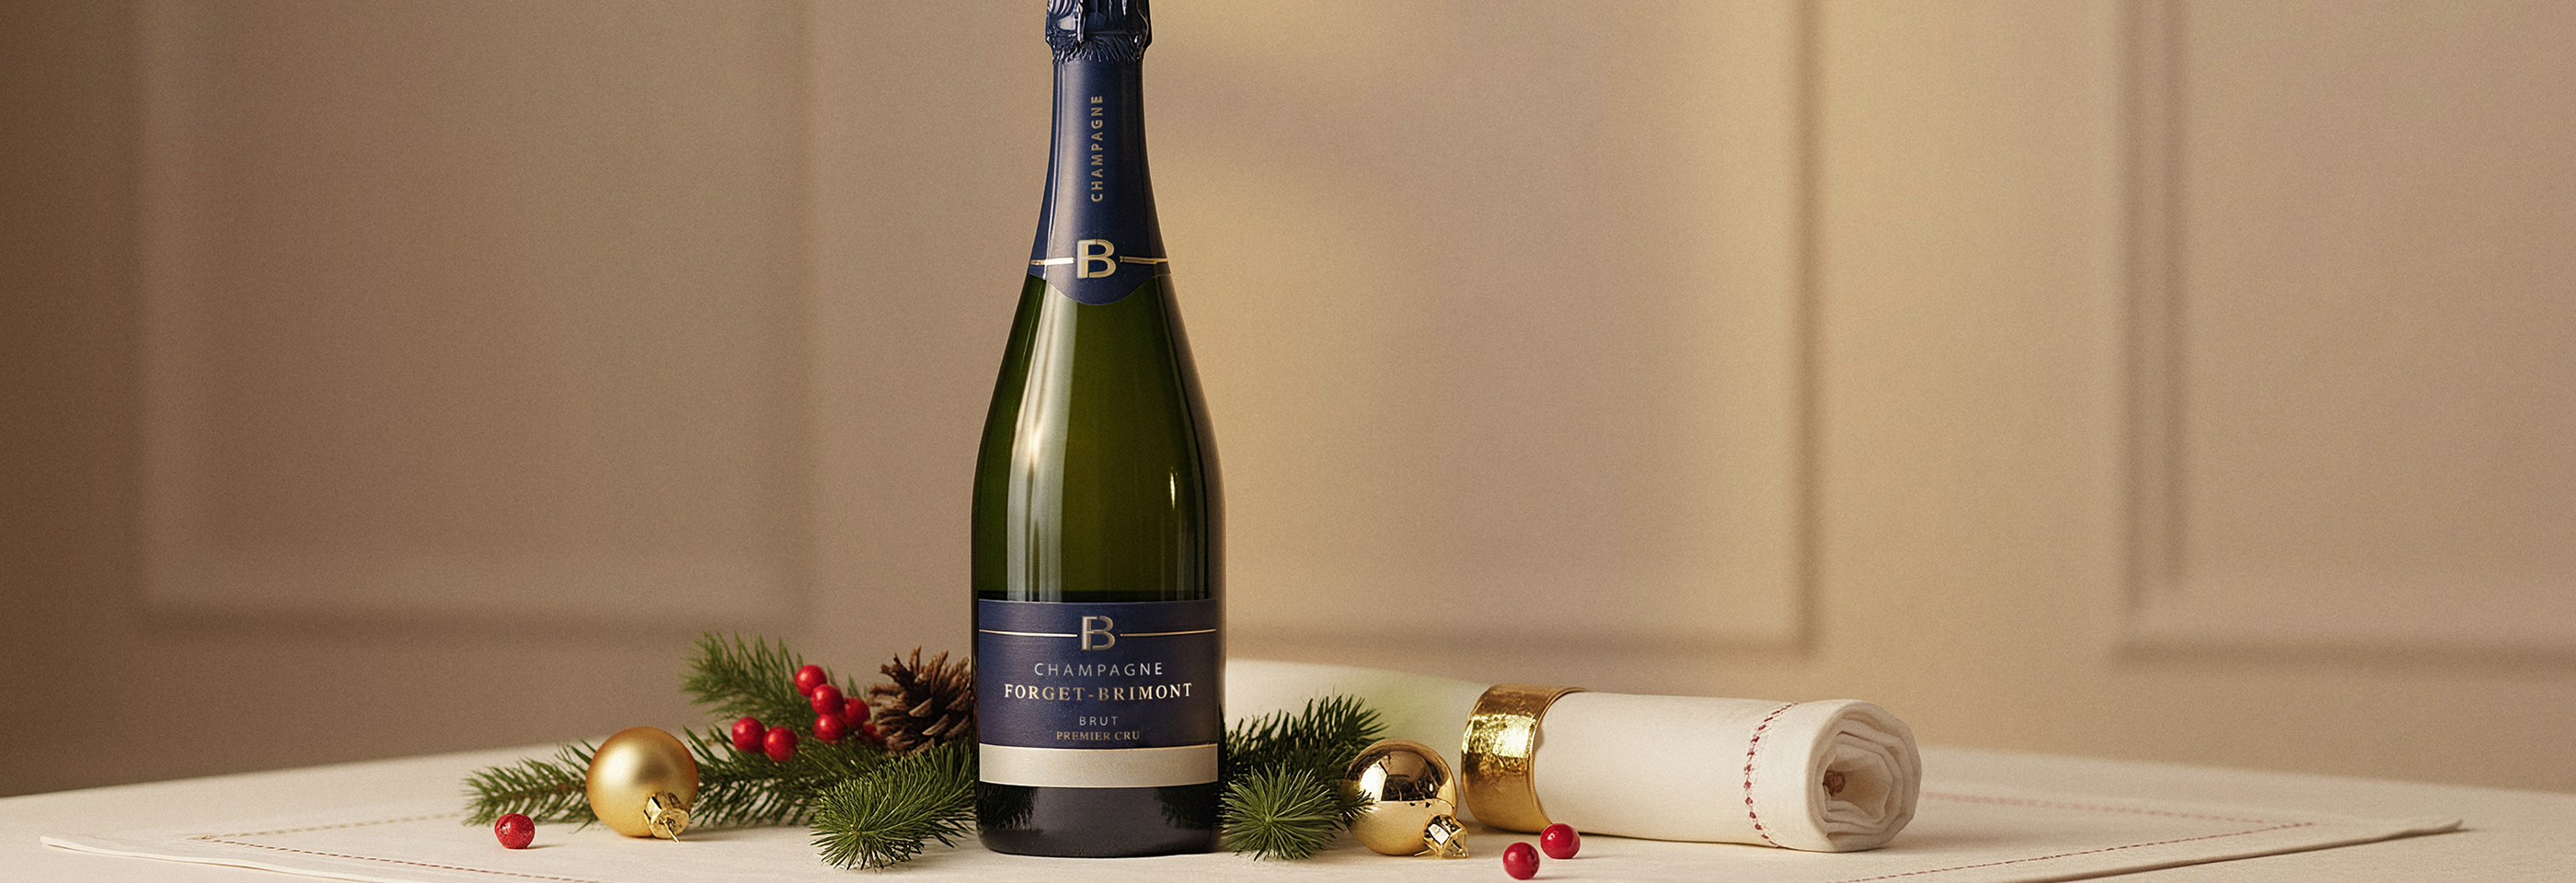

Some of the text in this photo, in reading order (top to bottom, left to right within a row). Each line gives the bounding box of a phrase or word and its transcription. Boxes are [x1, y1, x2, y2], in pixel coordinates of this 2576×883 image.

[1091, 96, 1103, 202] CHAMPAGNE
[1034, 662, 1163, 676] CHAMPAGNE
[1005, 682, 1192, 701] FORGET-BRIMONT
[1079, 716, 1119, 726] BRUT
[1056, 731, 1141, 740] PREMIER CRU
